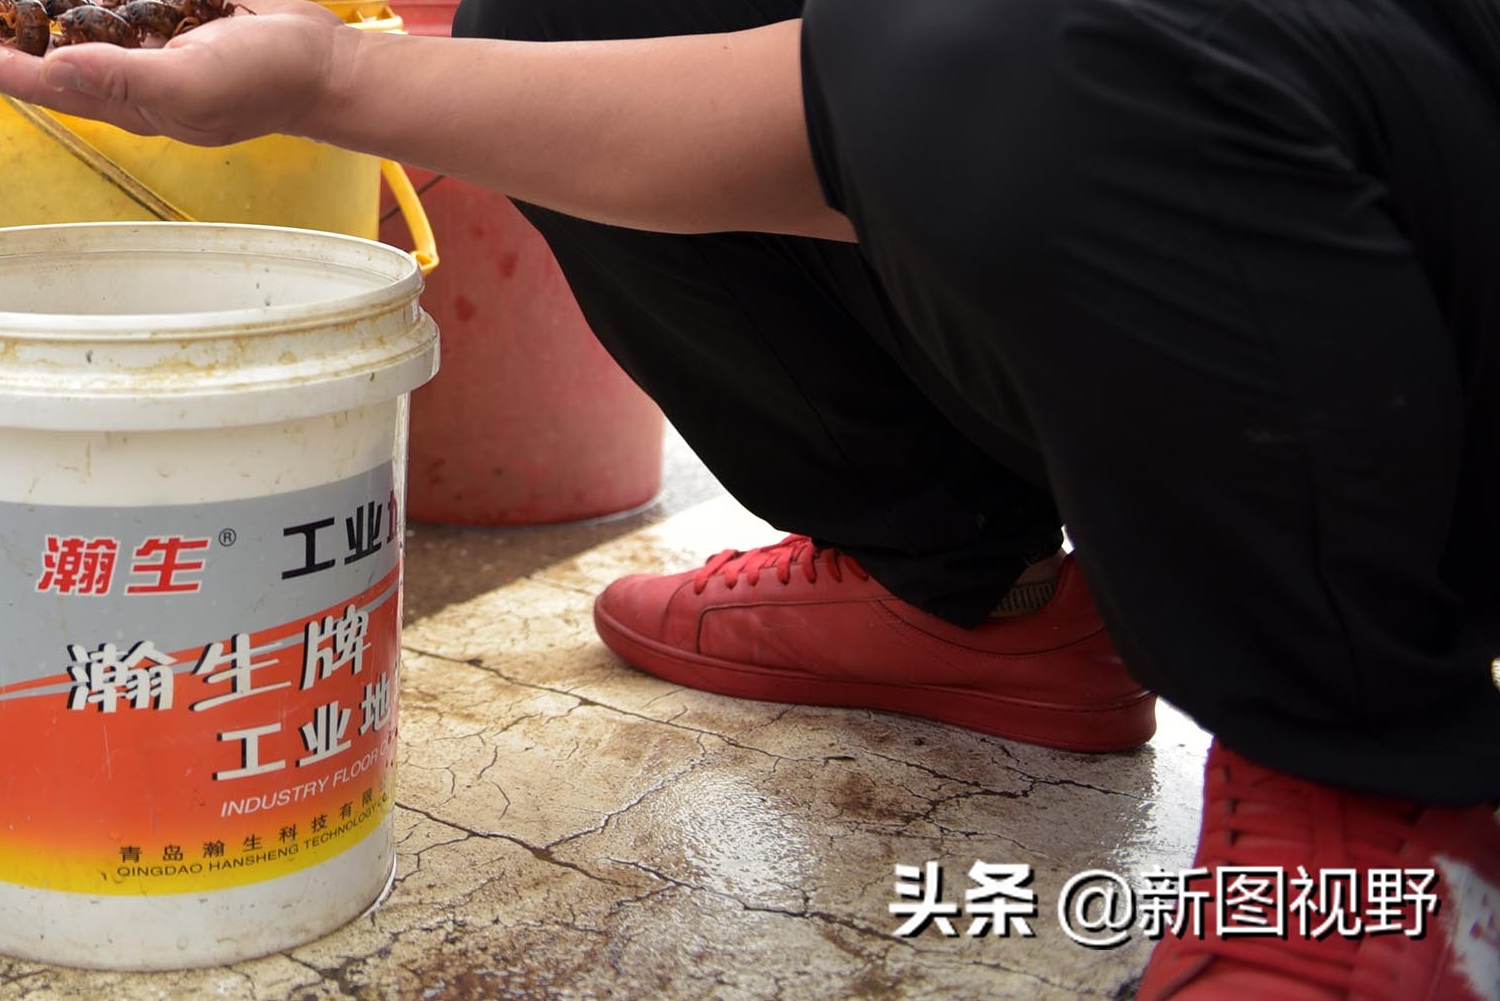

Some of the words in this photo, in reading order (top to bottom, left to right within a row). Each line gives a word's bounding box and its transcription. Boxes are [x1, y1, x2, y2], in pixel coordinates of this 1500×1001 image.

[35, 533, 212, 595] 瀚生
[66, 603, 372, 713] 瀚生牌
[220, 776, 329, 818] INDUSTRY
[332, 748, 379, 788] FLOOR
[116, 862, 204, 878] QINGDAO
[208, 844, 300, 873] HANSHENG
[303, 804, 376, 851] TECHNOLOGY
